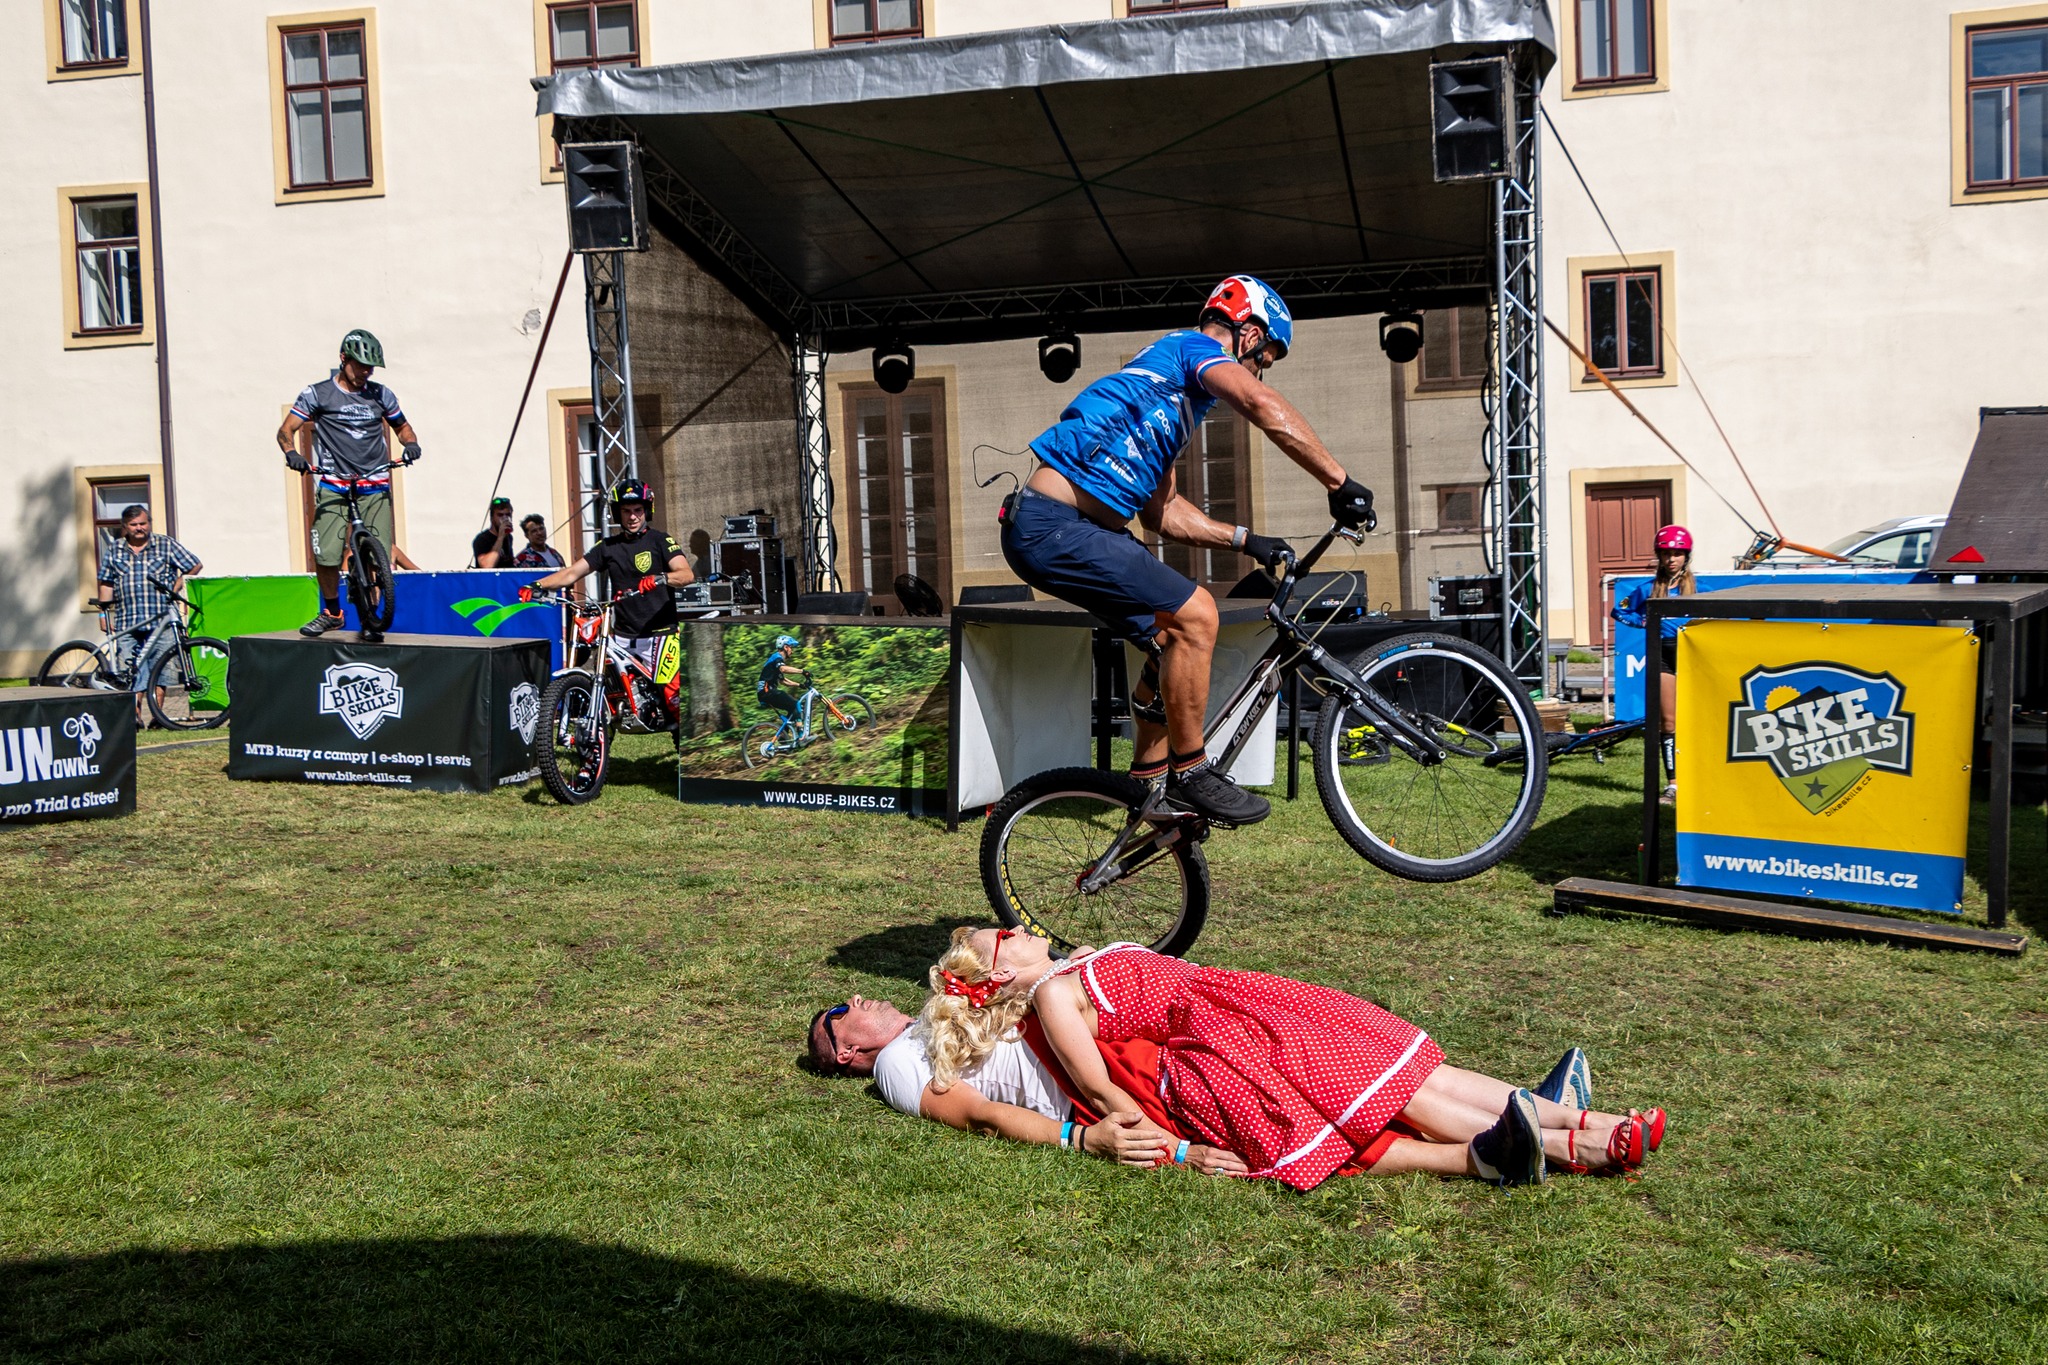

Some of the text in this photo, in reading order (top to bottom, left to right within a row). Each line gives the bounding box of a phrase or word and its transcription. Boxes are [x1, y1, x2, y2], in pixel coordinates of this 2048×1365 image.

[1236, 307, 1251, 319] POC
[1152, 408, 1172, 436] POC
[330, 676, 385, 709] BIKE
[348, 692, 397, 717] SKILLS
[1746, 687, 1876, 754] BIKE
[245, 743, 472, 767] MTB kurzy a campy e-shop servis
[1788, 723, 1899, 771] SKILLS
[305, 770, 412, 783] www.bikeskills.cz
[2, 803, 32, 819] pro
[35, 795, 69, 813] Trial
[71, 796, 81, 808] a
[82, 787, 120, 807] Street
[763, 790, 895, 809] WWW.CUBE-BIKES.CZ
[1824, 775, 1873, 817] bikeskills.cz
[1704, 854, 1918, 889] www.bikeskills.cz
